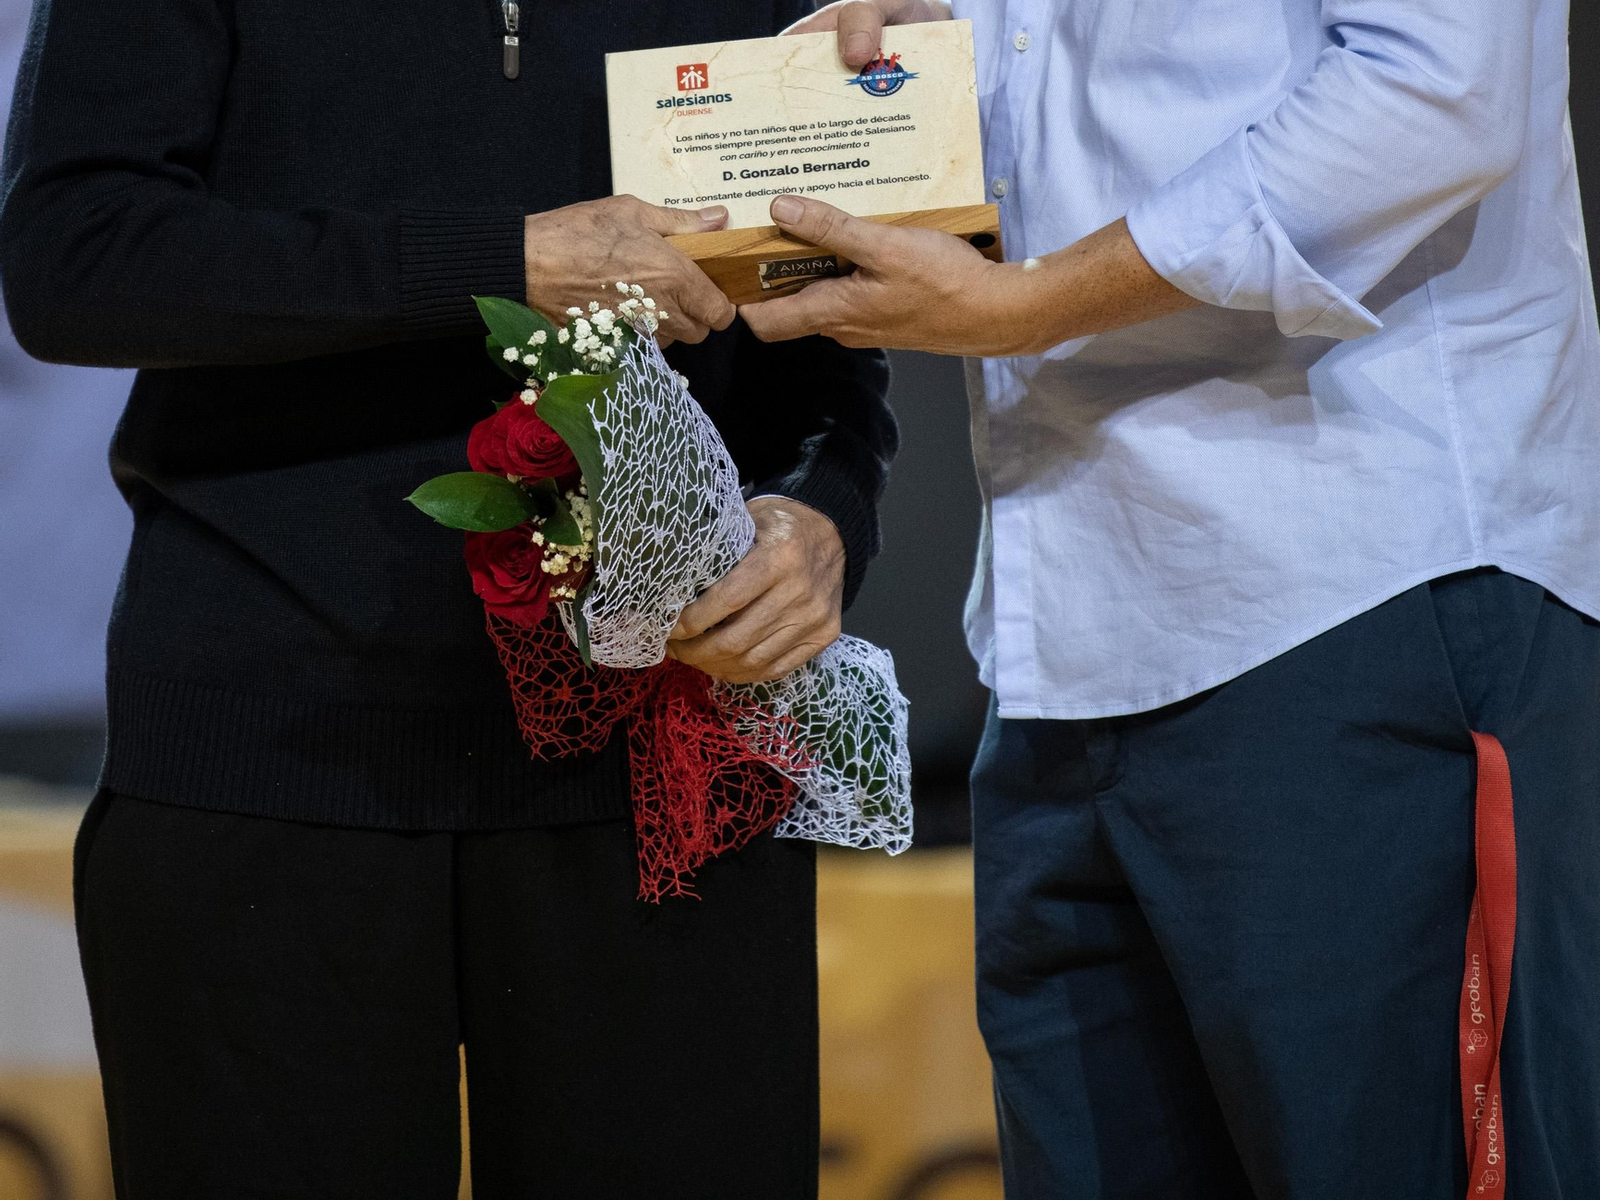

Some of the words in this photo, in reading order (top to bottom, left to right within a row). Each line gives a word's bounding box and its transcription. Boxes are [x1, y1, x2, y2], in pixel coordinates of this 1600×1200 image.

[875, 72, 904, 80] BOSCO
[656, 93, 733, 109] salesianos
[676, 107, 713, 117] OURENSE
[684, 144, 712, 152] vimos
[714, 141, 752, 150] siempre
[754, 136, 796, 147] presente
[813, 132, 822, 140] el
[824, 130, 848, 140] patio
[850, 128, 863, 136] de
[865, 124, 916, 135] Salesianos
[694, 132, 720, 140] niños
[744, 128, 760, 136] tan
[761, 125, 787, 134] niños
[788, 124, 808, 132] que
[829, 119, 854, 128] largo
[870, 113, 911, 123] décadas
[720, 154, 736, 162] con
[739, 150, 768, 159] cariño
[770, 150, 776, 158] y
[790, 142, 862, 155] reconocimiento
[722, 171, 736, 181] D.
[740, 165, 799, 179] Gonzalo
[803, 158, 870, 173] Bernardo
[696, 192, 743, 202] constante
[744, 186, 797, 198] dedicación
[798, 186, 805, 194] y
[806, 183, 836, 193] apoyo
[838, 180, 863, 188] hacia
[865, 178, 874, 186] el
[877, 173, 932, 185] baloncesto.
[780, 260, 835, 272] AIXIÑA
[1468, 953, 1486, 1024] geoban
[1487, 1094, 1501, 1165] geoban
